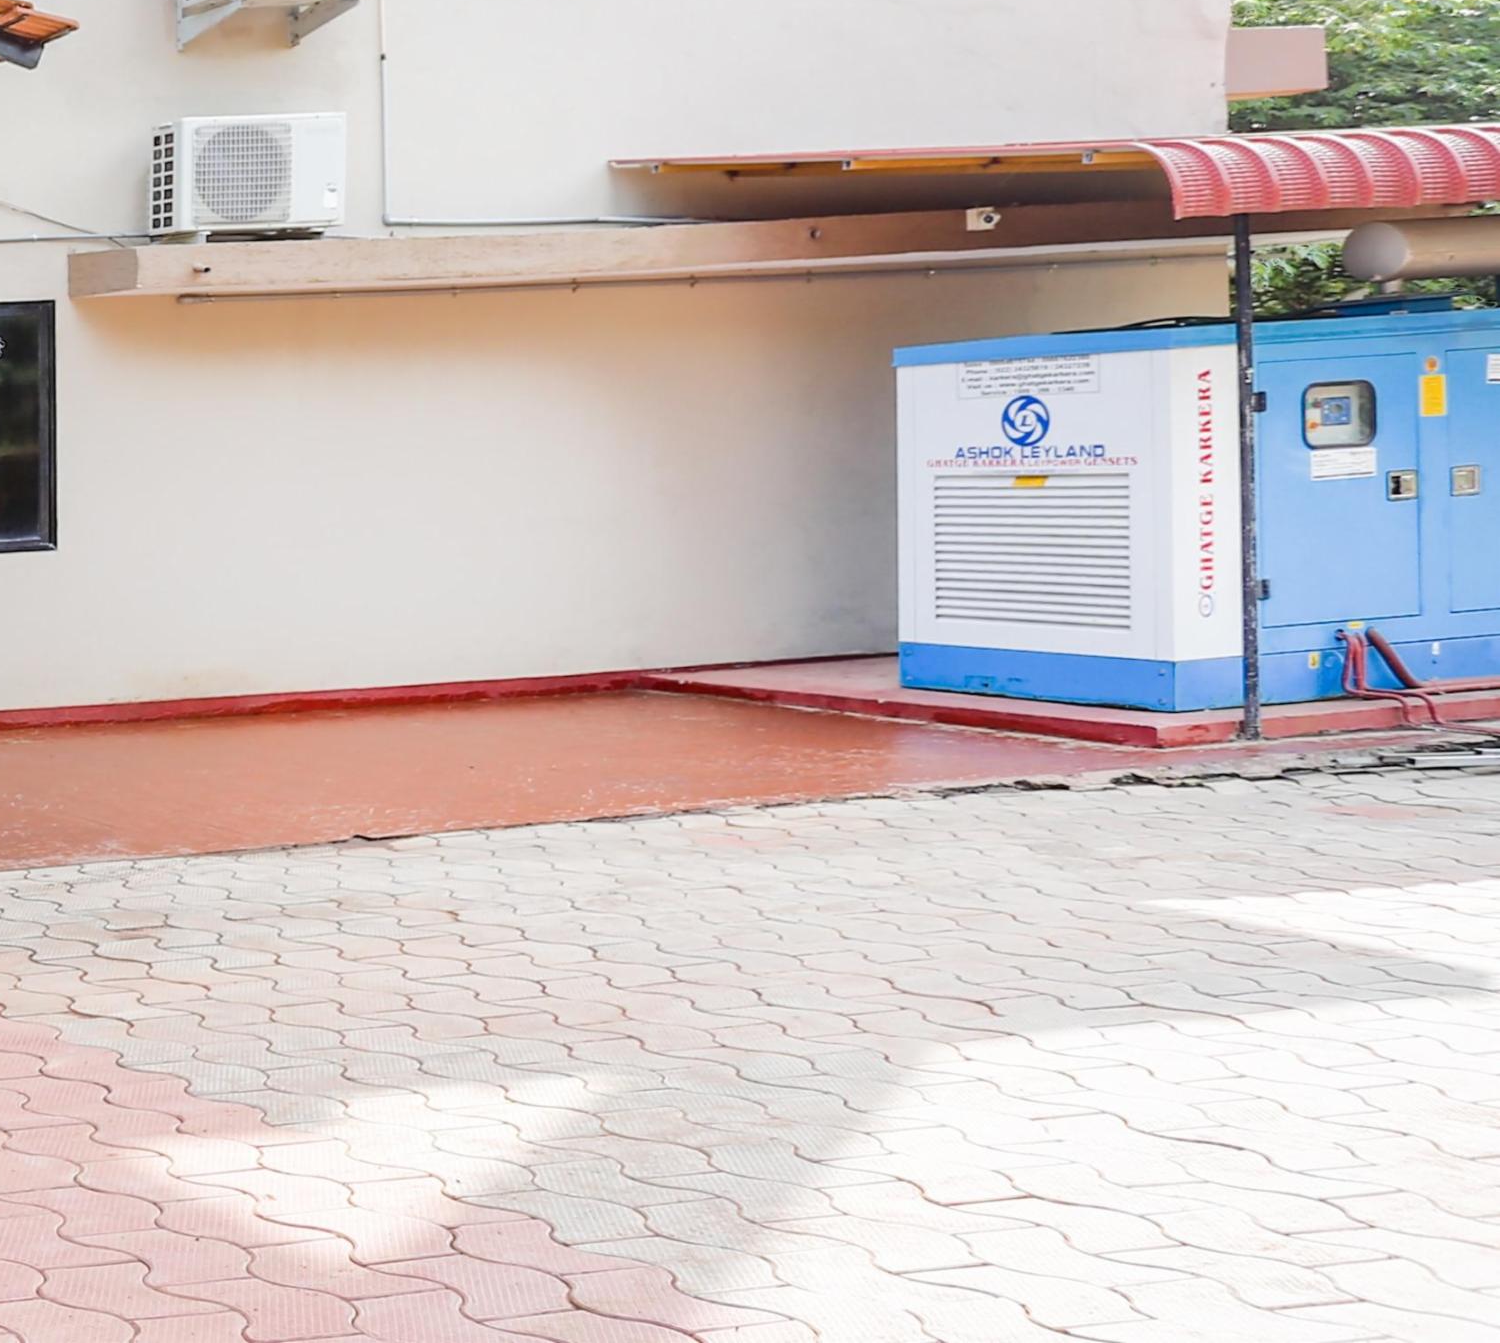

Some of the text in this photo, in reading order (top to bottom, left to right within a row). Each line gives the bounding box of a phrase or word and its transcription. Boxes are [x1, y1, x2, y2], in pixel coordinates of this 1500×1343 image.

[955, 444, 1106, 459] ASHOK LEYLAND
[1197, 369, 1214, 591] GHATGE KARKERA
